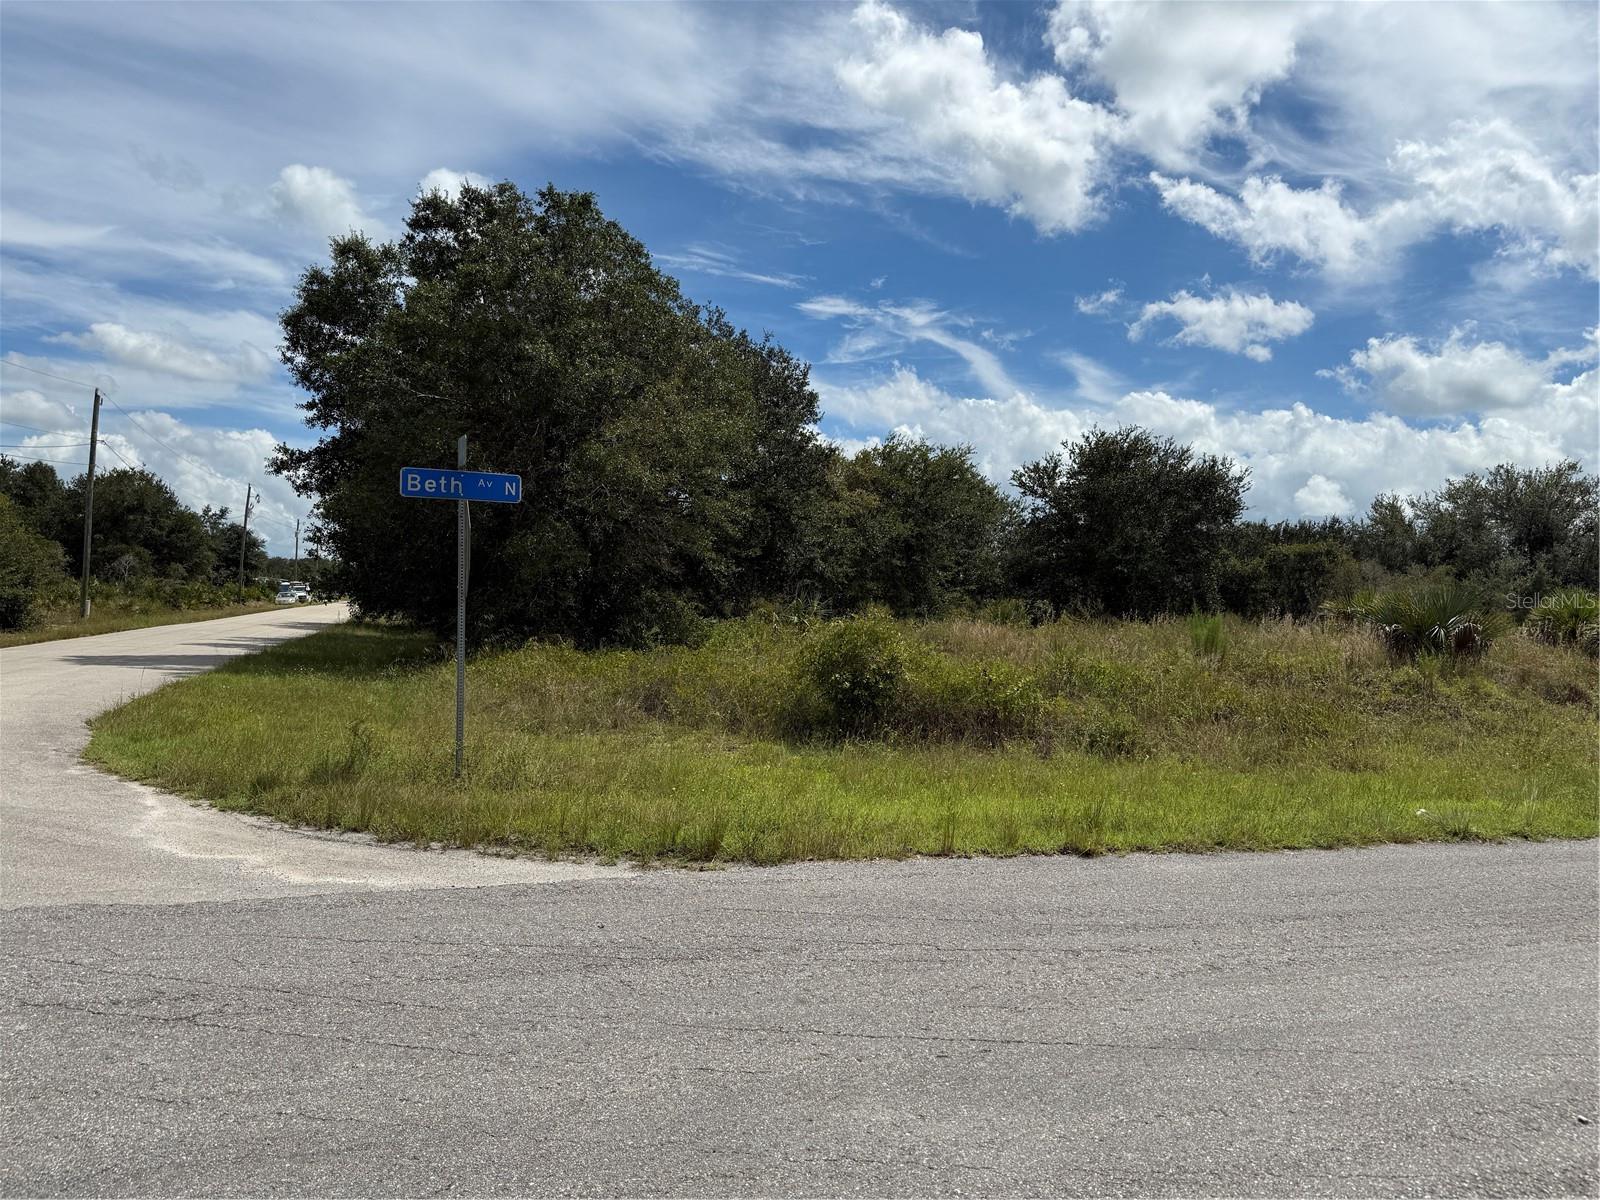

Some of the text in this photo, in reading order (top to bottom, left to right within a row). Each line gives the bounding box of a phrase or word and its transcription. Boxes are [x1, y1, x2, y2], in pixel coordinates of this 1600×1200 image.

[407, 474, 516, 496] Beth Av N
